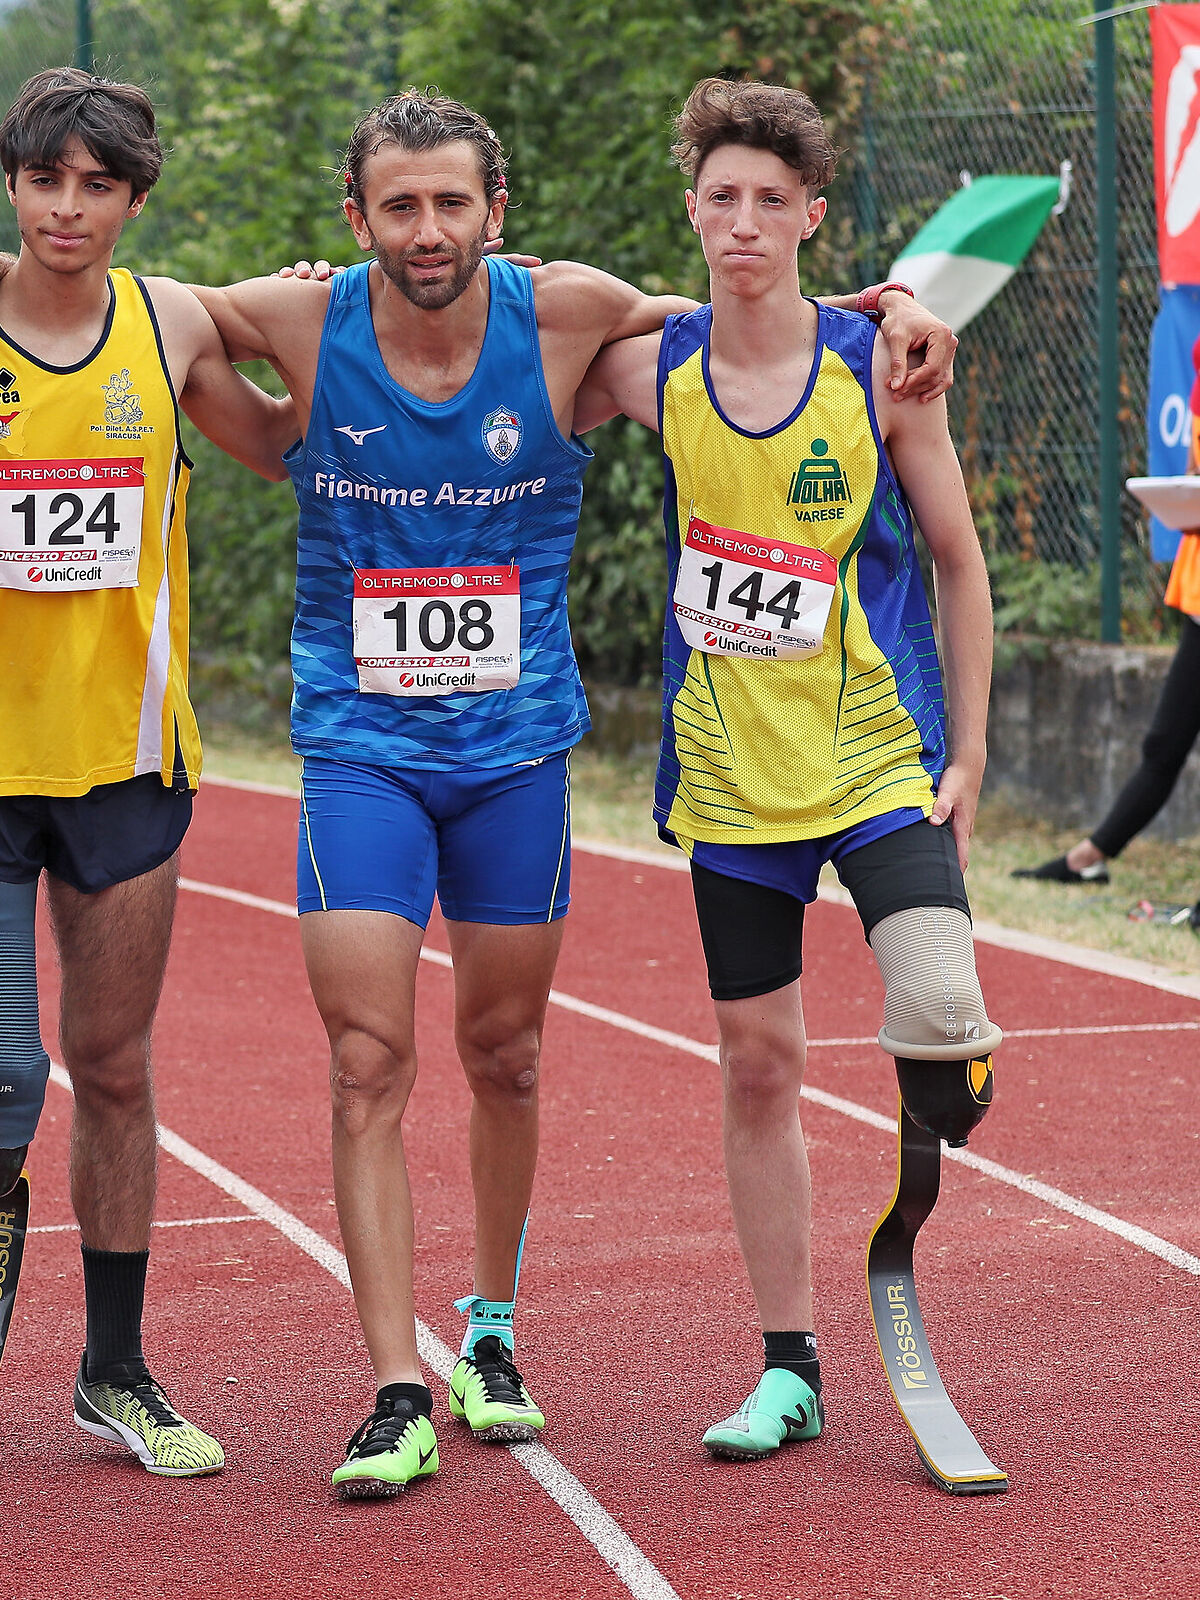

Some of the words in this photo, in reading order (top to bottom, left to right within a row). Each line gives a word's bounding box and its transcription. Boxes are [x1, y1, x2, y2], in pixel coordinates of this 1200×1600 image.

[315, 472, 428, 506] Fiamme
[433, 477, 547, 506] Azzurre
[11, 492, 121, 546] 124
[794, 507, 846, 522] VARESE
[60, 551, 96, 561] 2021
[44, 566, 103, 582] UniCredit
[701, 561, 802, 630] 144
[383, 600, 495, 652] 108
[676, 605, 735, 632] CONCESIO
[736, 626, 770, 641] 2021
[718, 635, 778, 658] UniCredit
[360, 657, 430, 667] CONCESIO
[430, 657, 468, 667] 2021
[416, 673, 477, 688] UniCredit
